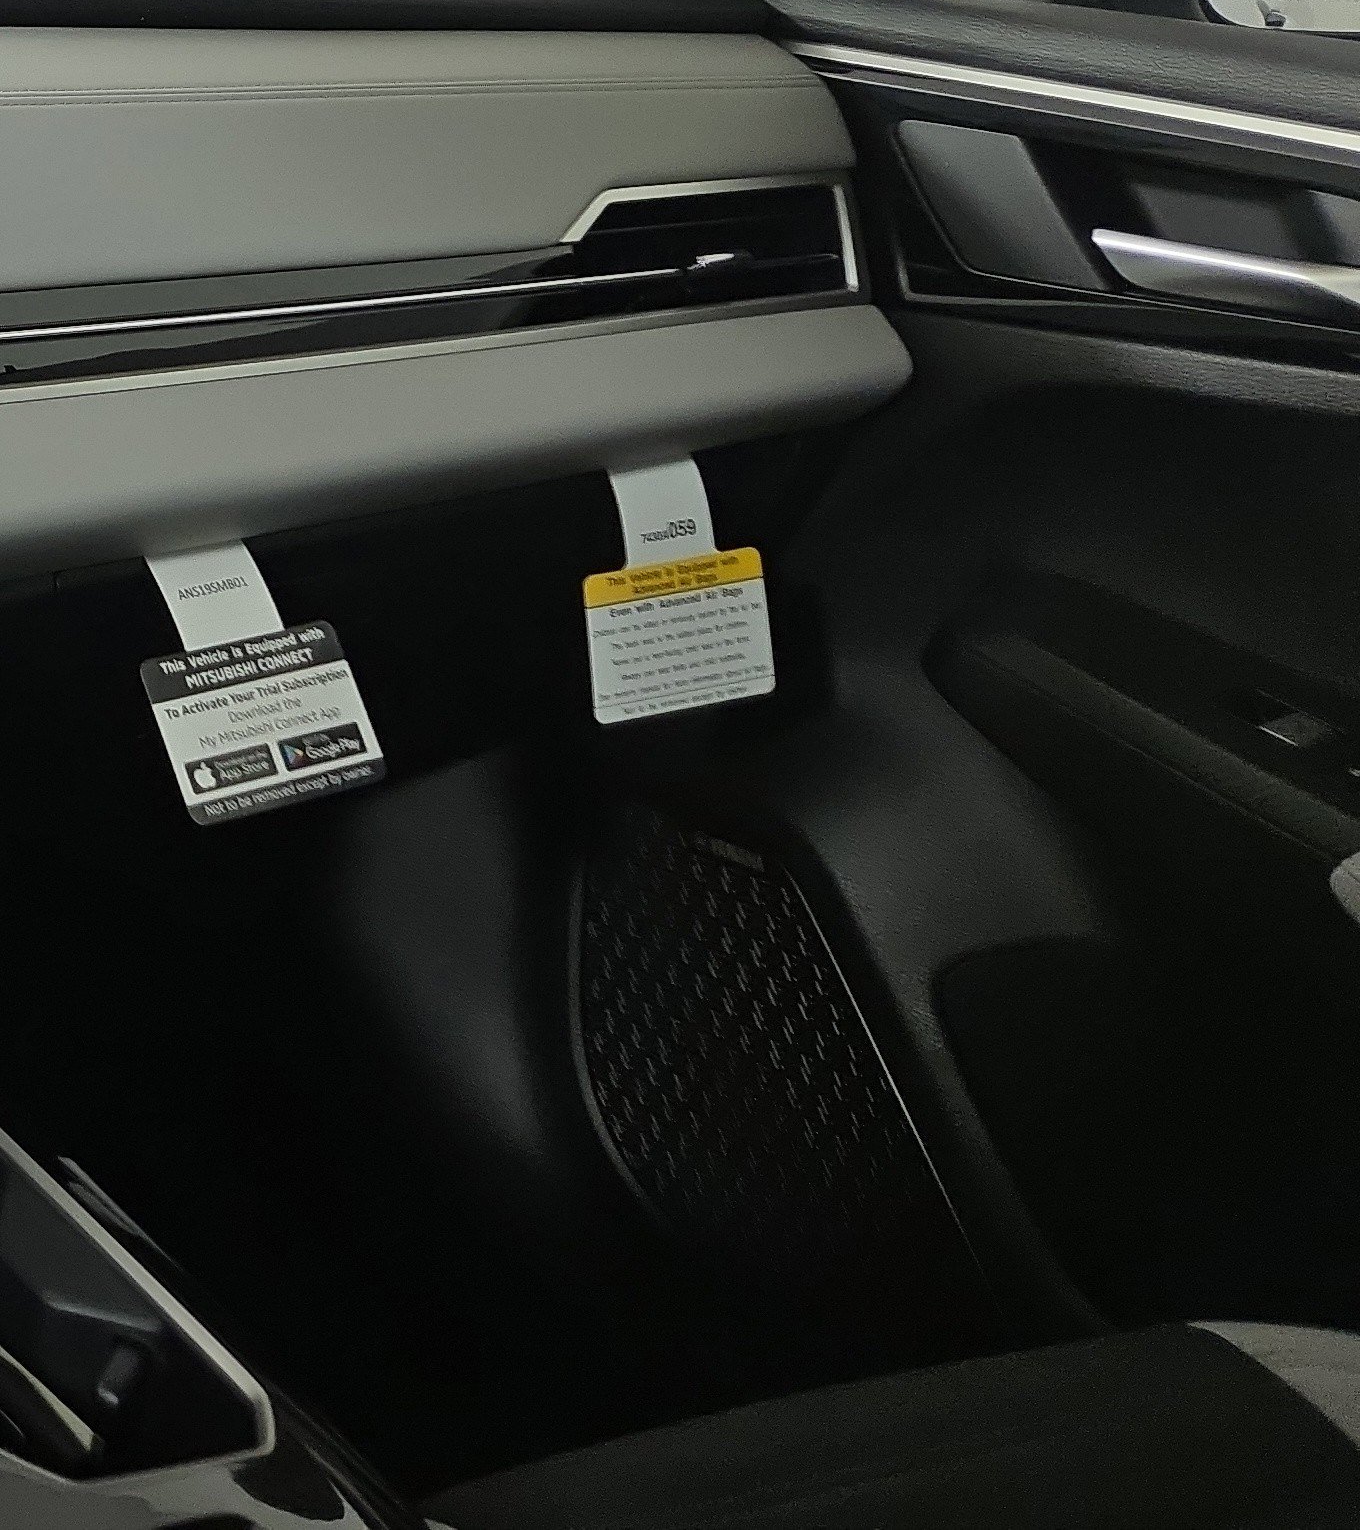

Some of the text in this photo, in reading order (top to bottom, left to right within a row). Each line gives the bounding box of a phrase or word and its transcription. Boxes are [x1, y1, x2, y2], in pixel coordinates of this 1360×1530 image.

[609, 605, 633, 619] Even
[636, 601, 655, 614] with
[659, 594, 702, 610] Advanced
[159, 659, 187, 676] This
[189, 649, 230, 669] Vehicle
[245, 634, 298, 660] Equipped
[299, 626, 326, 644] with
[184, 647, 315, 690] MITSUBISHI CONNECT
[164, 669, 350, 721] To Activate Your Trial Subscription
[198, 736, 218, 750] My
[218, 723, 276, 747] Mitsubishi
[203, 803, 224, 817] Not
